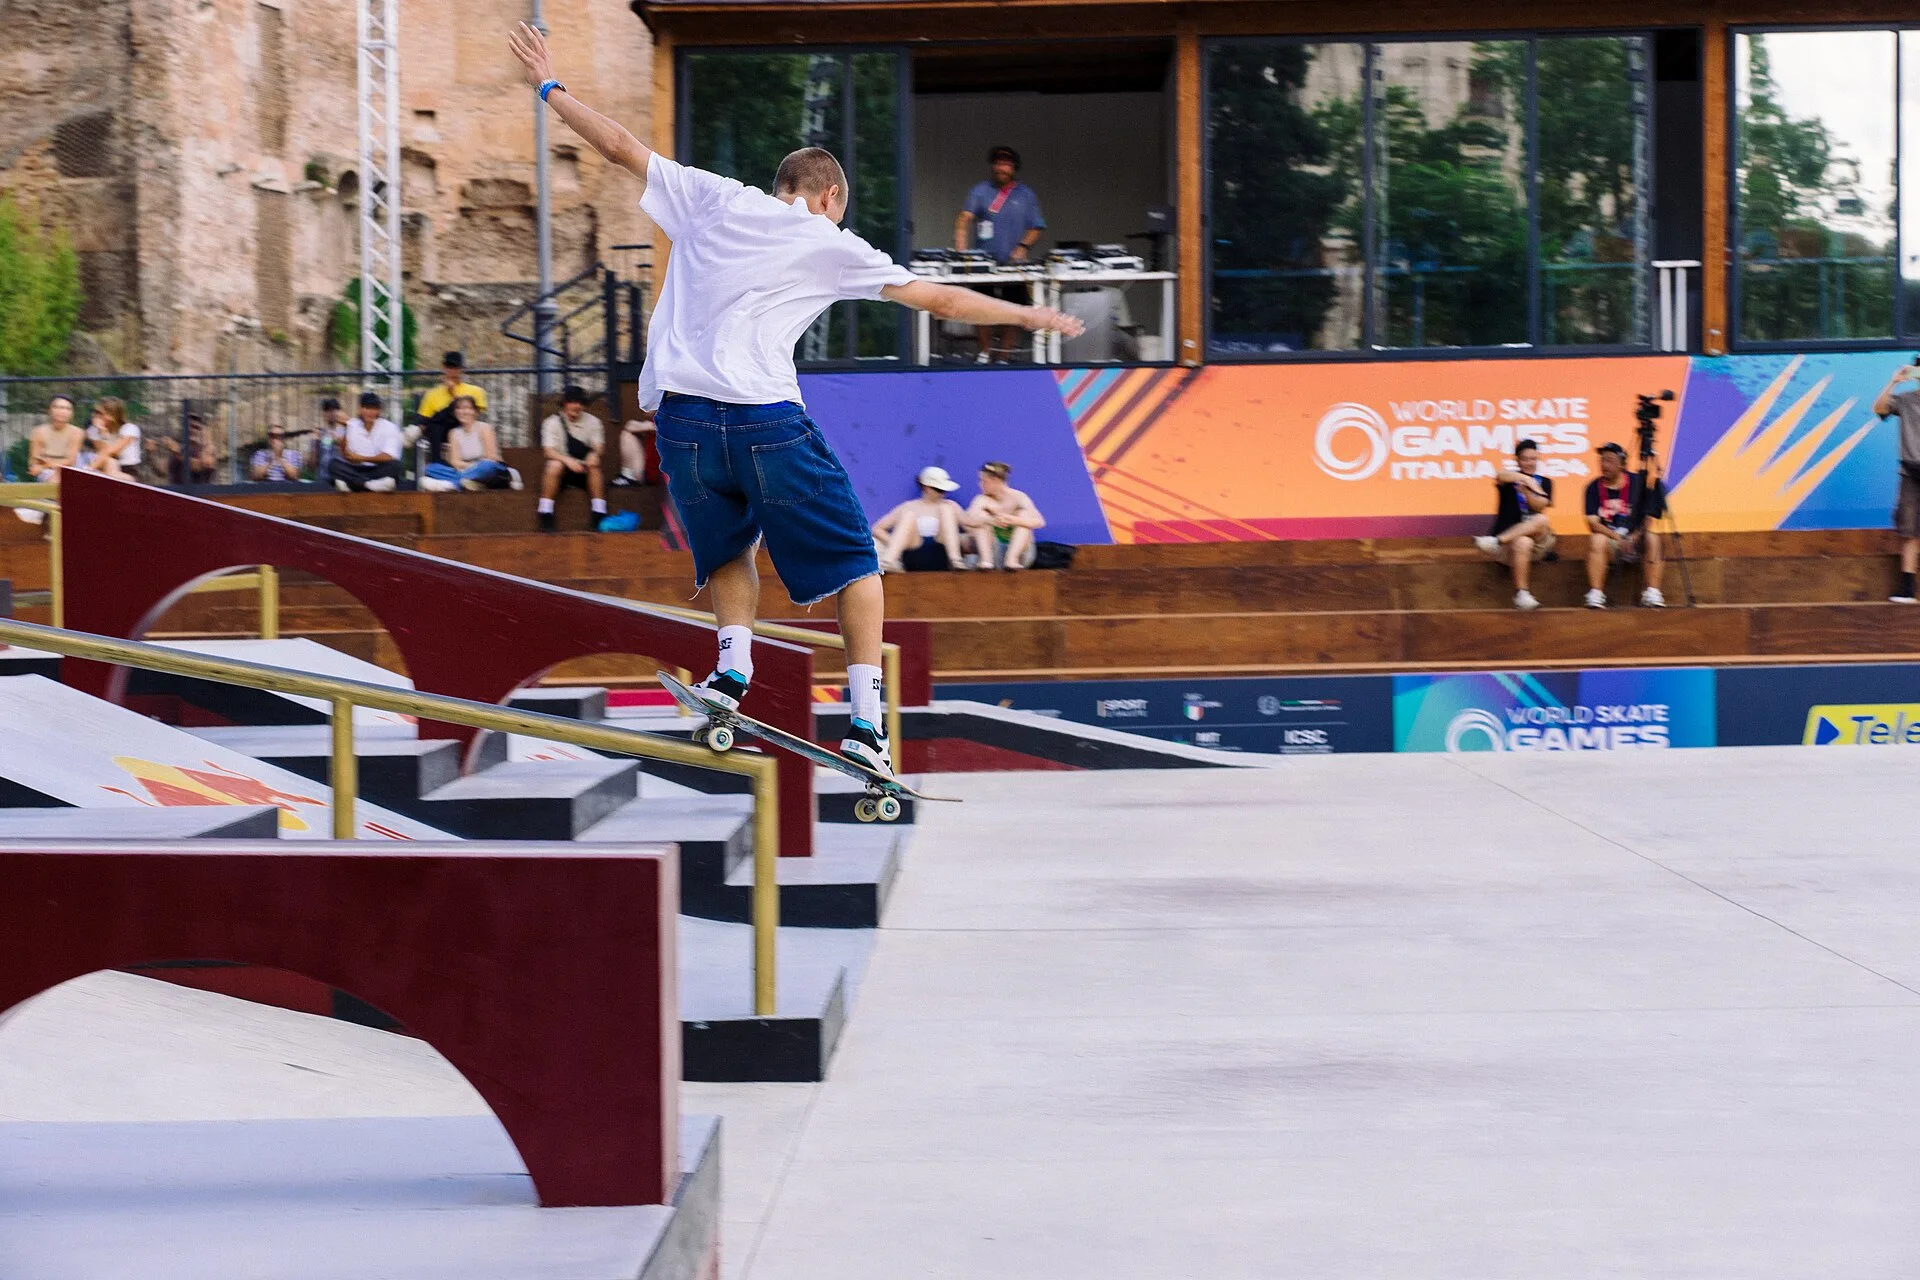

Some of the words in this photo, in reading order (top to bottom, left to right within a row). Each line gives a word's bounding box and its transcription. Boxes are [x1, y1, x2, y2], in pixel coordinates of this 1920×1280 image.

[1389, 400, 1496, 421] WORLD
[1499, 398, 1589, 420] SKATE
[1391, 423, 1590, 456] GAMES
[1390, 459, 1498, 480] ITALIA
[1505, 705, 1594, 725] WORLD
[1595, 703, 1670, 723] SKATE
[1506, 725, 1671, 751] GAMES
[1850, 711, 1920, 745] Tele
